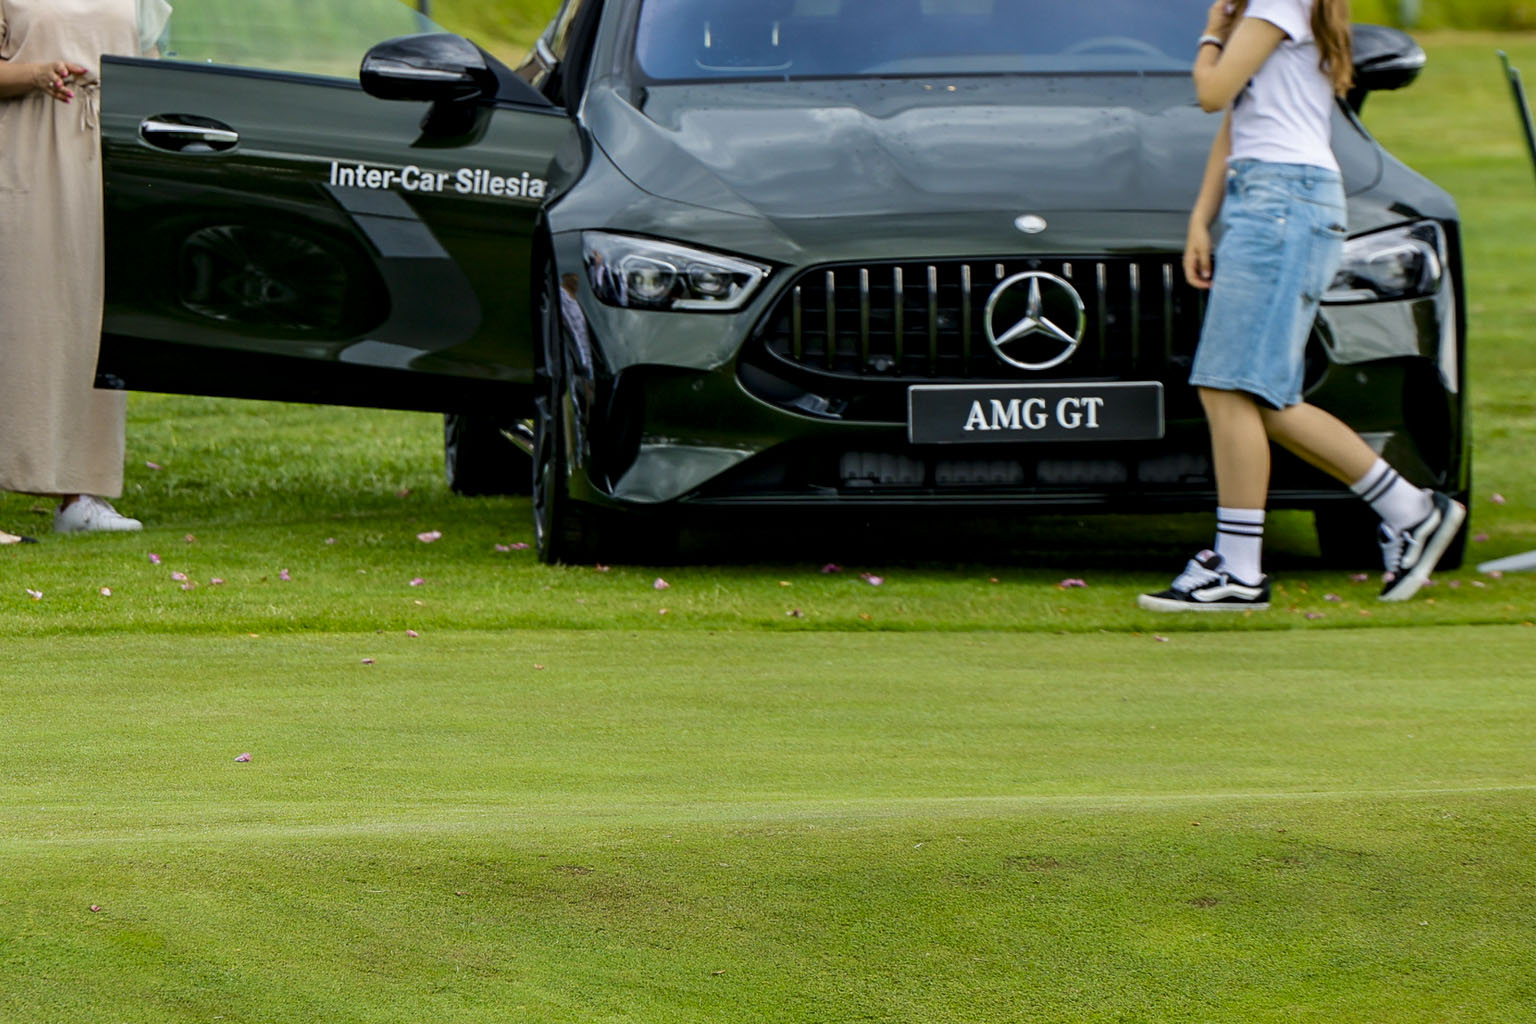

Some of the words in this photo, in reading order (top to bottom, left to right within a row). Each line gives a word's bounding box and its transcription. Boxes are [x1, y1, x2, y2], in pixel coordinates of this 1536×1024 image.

[330, 161, 449, 193] Inter-Car
[455, 167, 547, 198] Silesia
[963, 397, 1049, 431] AMG
[1056, 396, 1104, 429] GT
